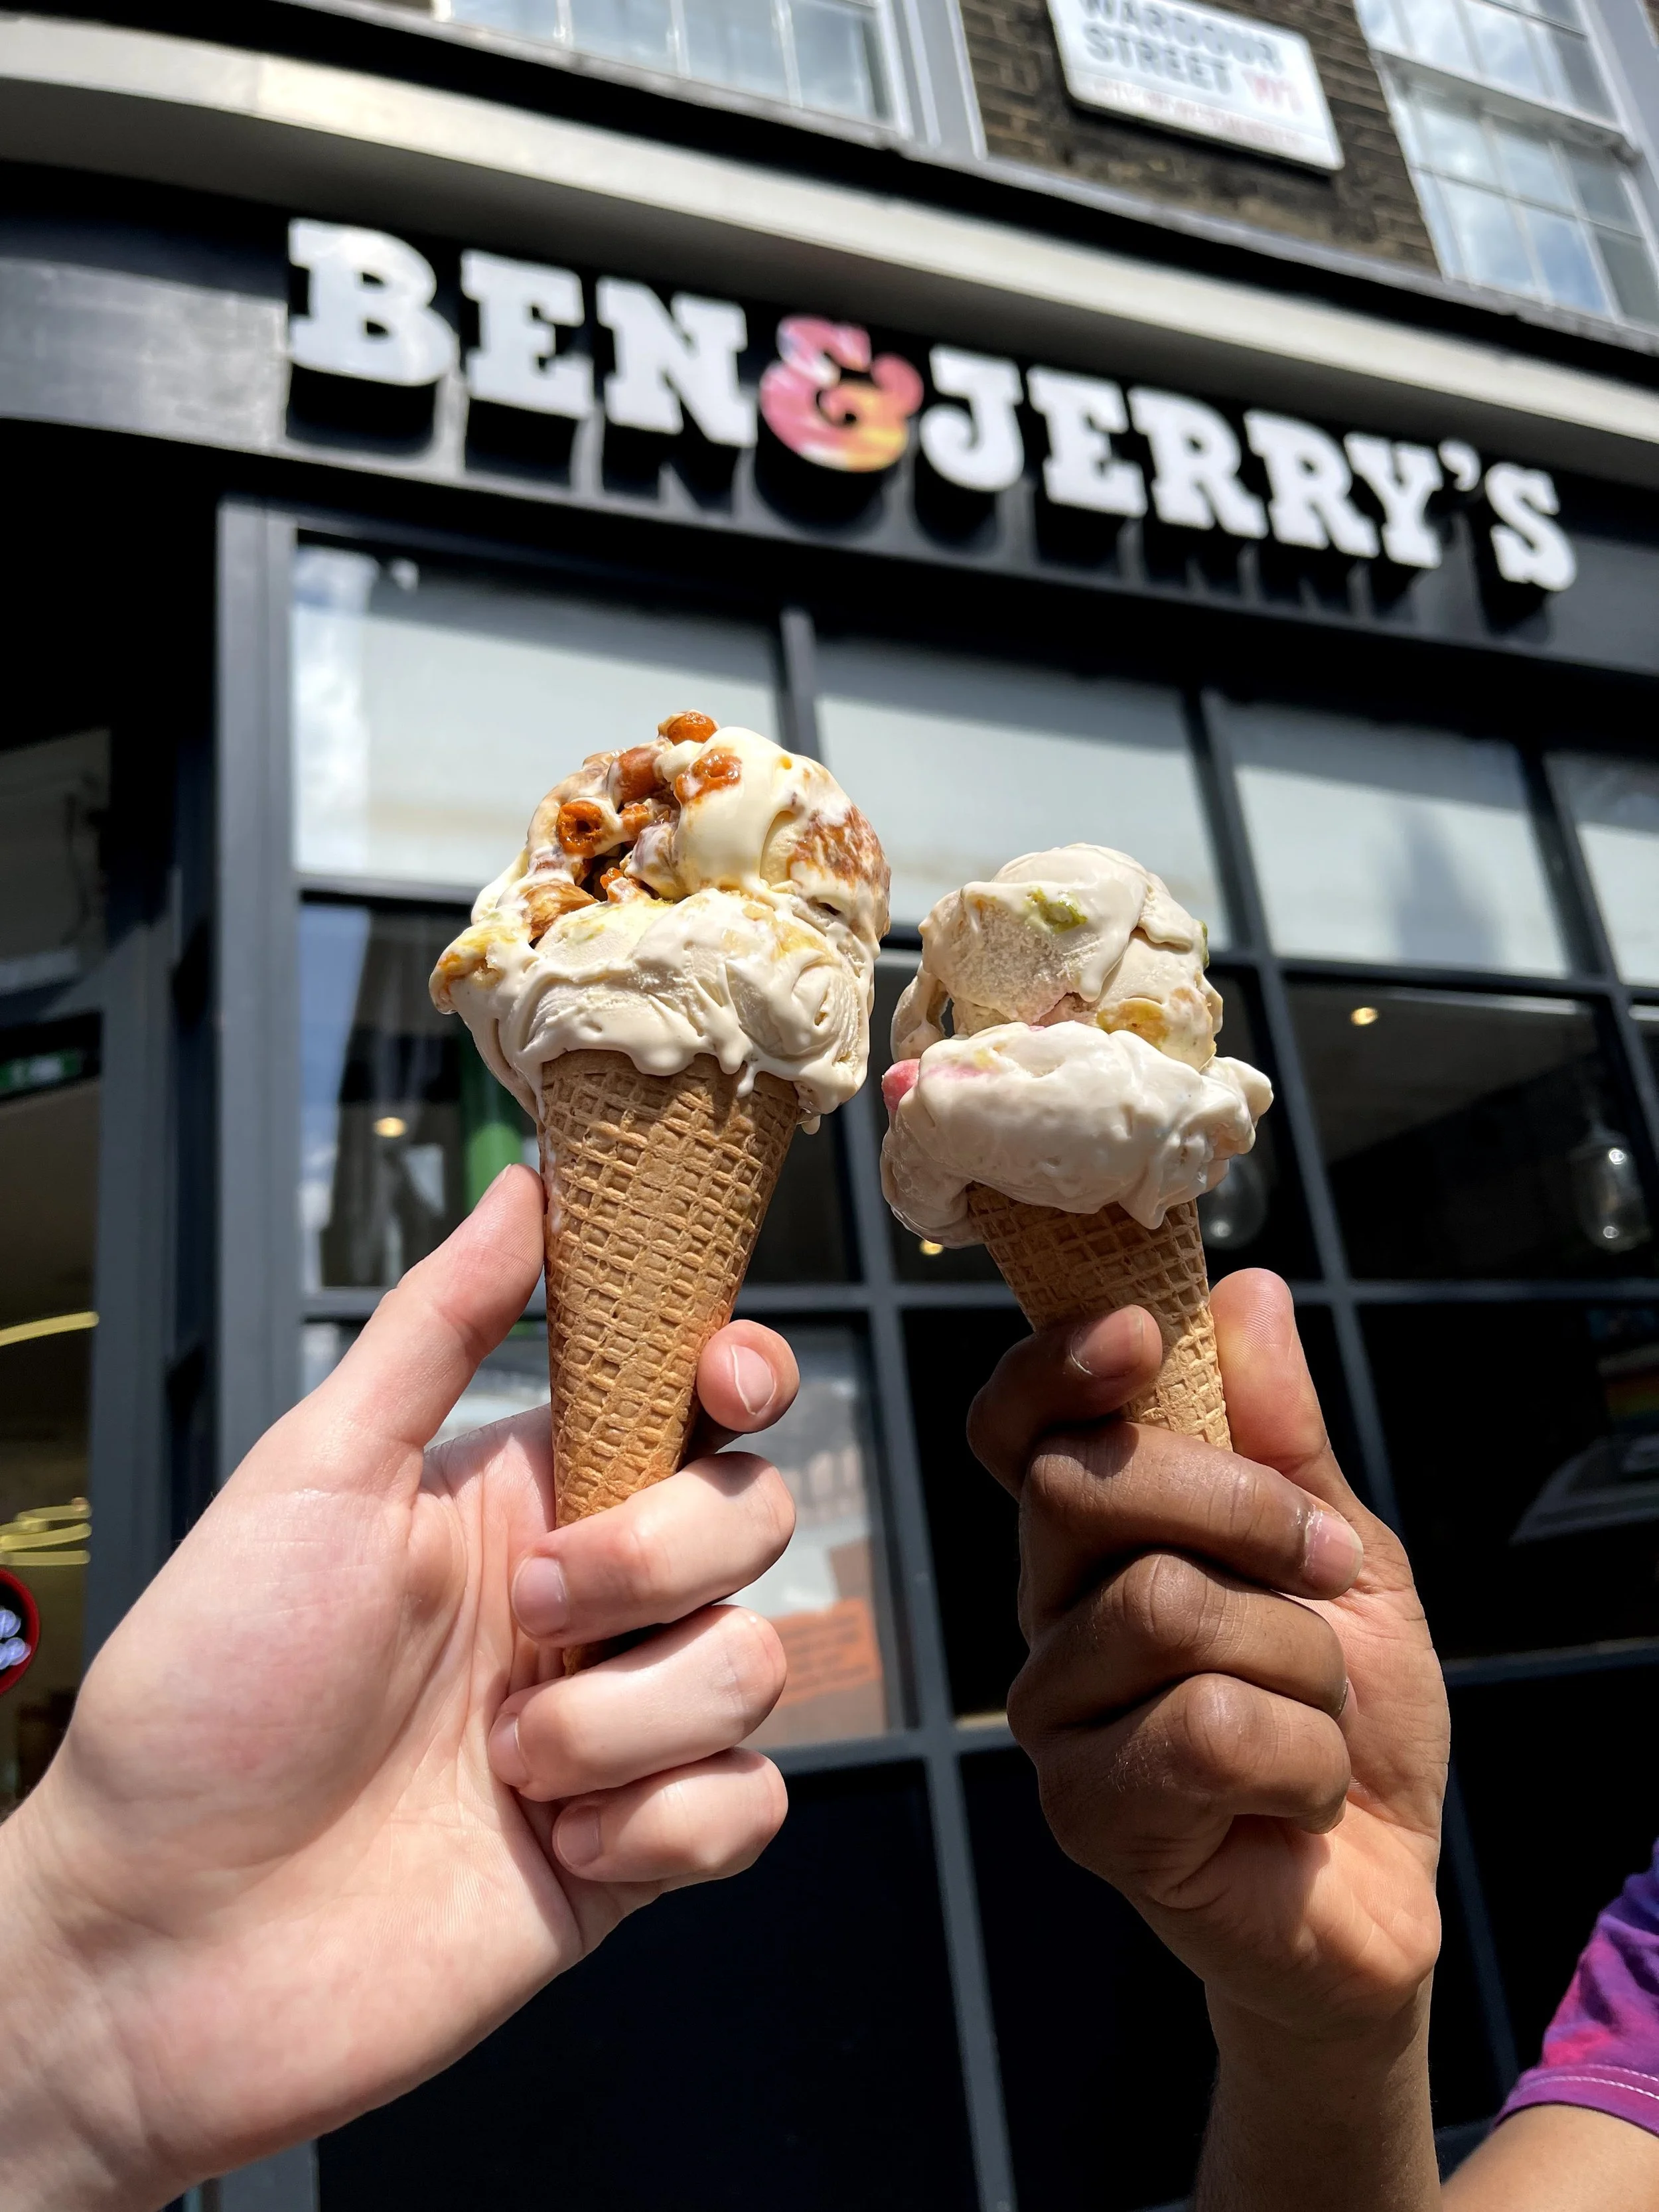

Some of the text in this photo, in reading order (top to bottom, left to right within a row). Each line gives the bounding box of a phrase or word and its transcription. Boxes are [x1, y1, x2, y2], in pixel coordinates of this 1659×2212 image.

[1083, 21, 1232, 94] STREET
[288, 218, 1577, 592] BEN & JERRY'S
